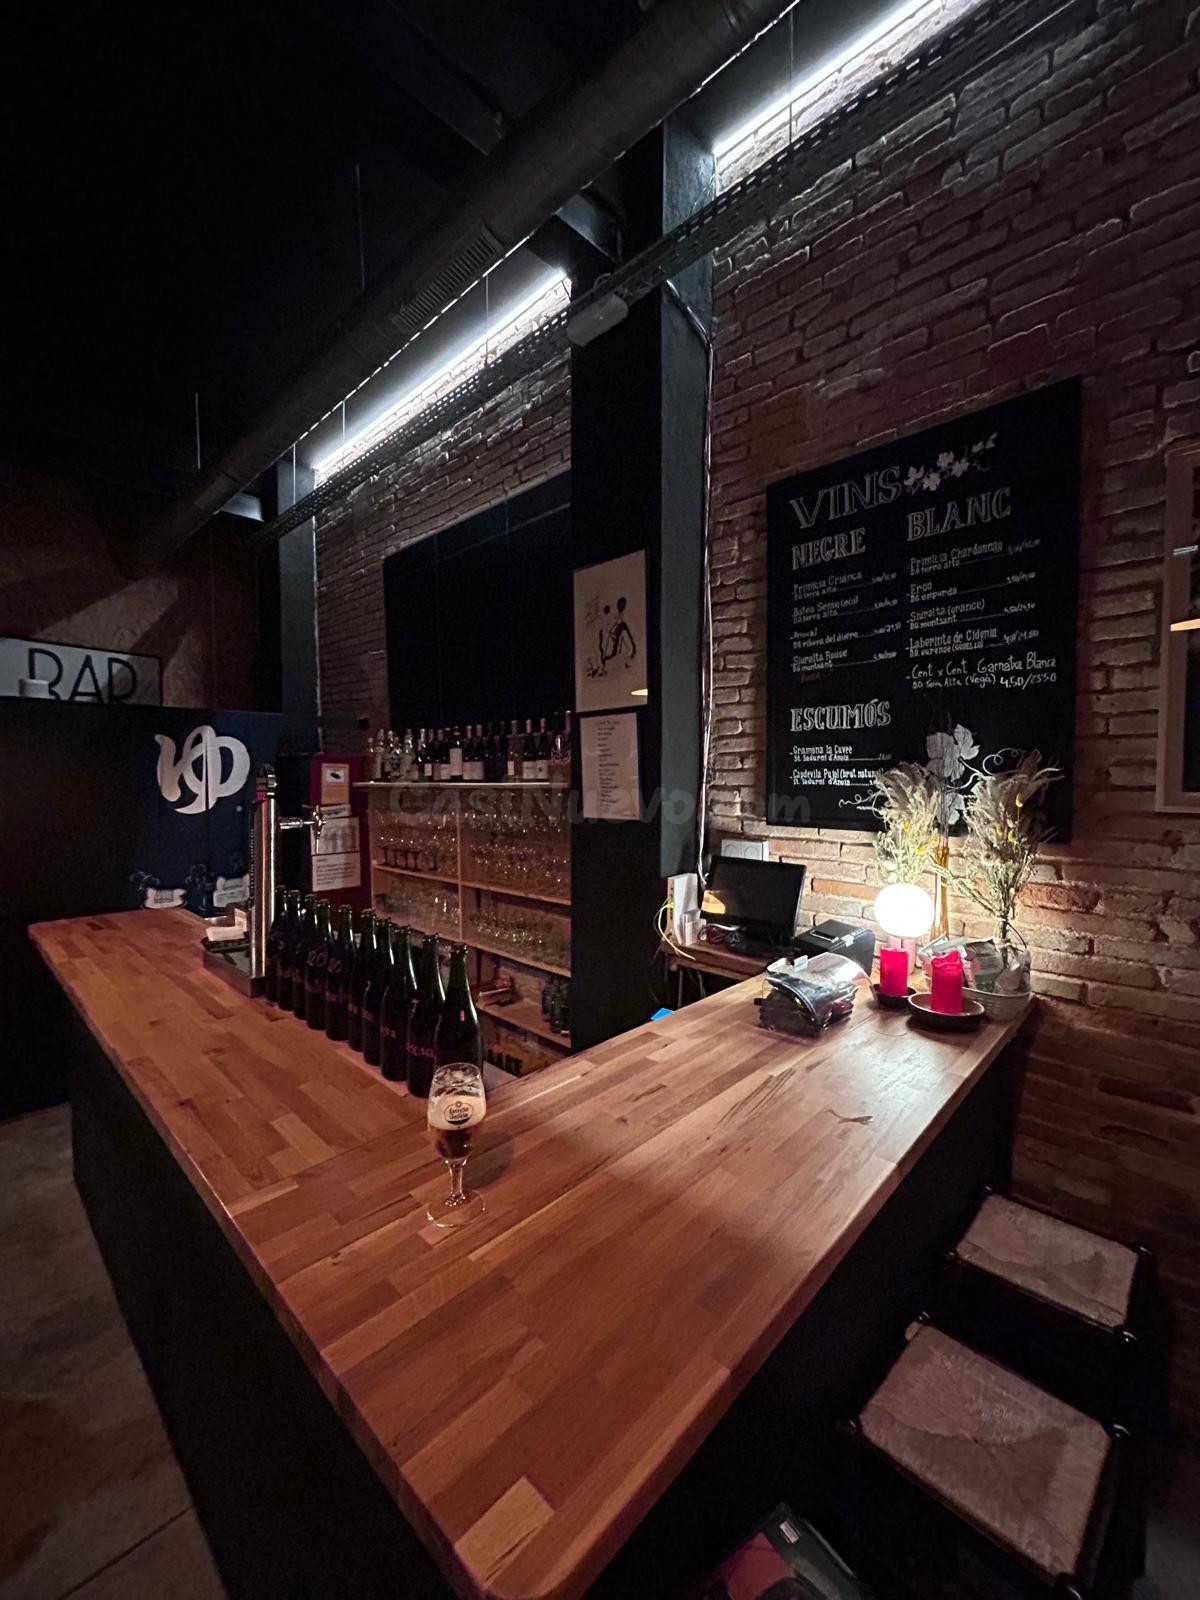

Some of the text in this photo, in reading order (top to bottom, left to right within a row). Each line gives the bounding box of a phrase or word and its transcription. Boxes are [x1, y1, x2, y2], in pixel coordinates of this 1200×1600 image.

[789, 464, 902, 529] VINS
[906, 486, 1011, 542] BLANC
[792, 527, 866, 571] NEGRE
[911, 663, 934, 679] Cent
[946, 658, 968, 676] Cent
[1026, 650, 1057, 670] Blanca
[944, 677, 962, 686] Alta
[790, 698, 892, 732] ESCUMÓS
[793, 745, 824, 754] Gramona
[793, 769, 821, 779] Capdevila
